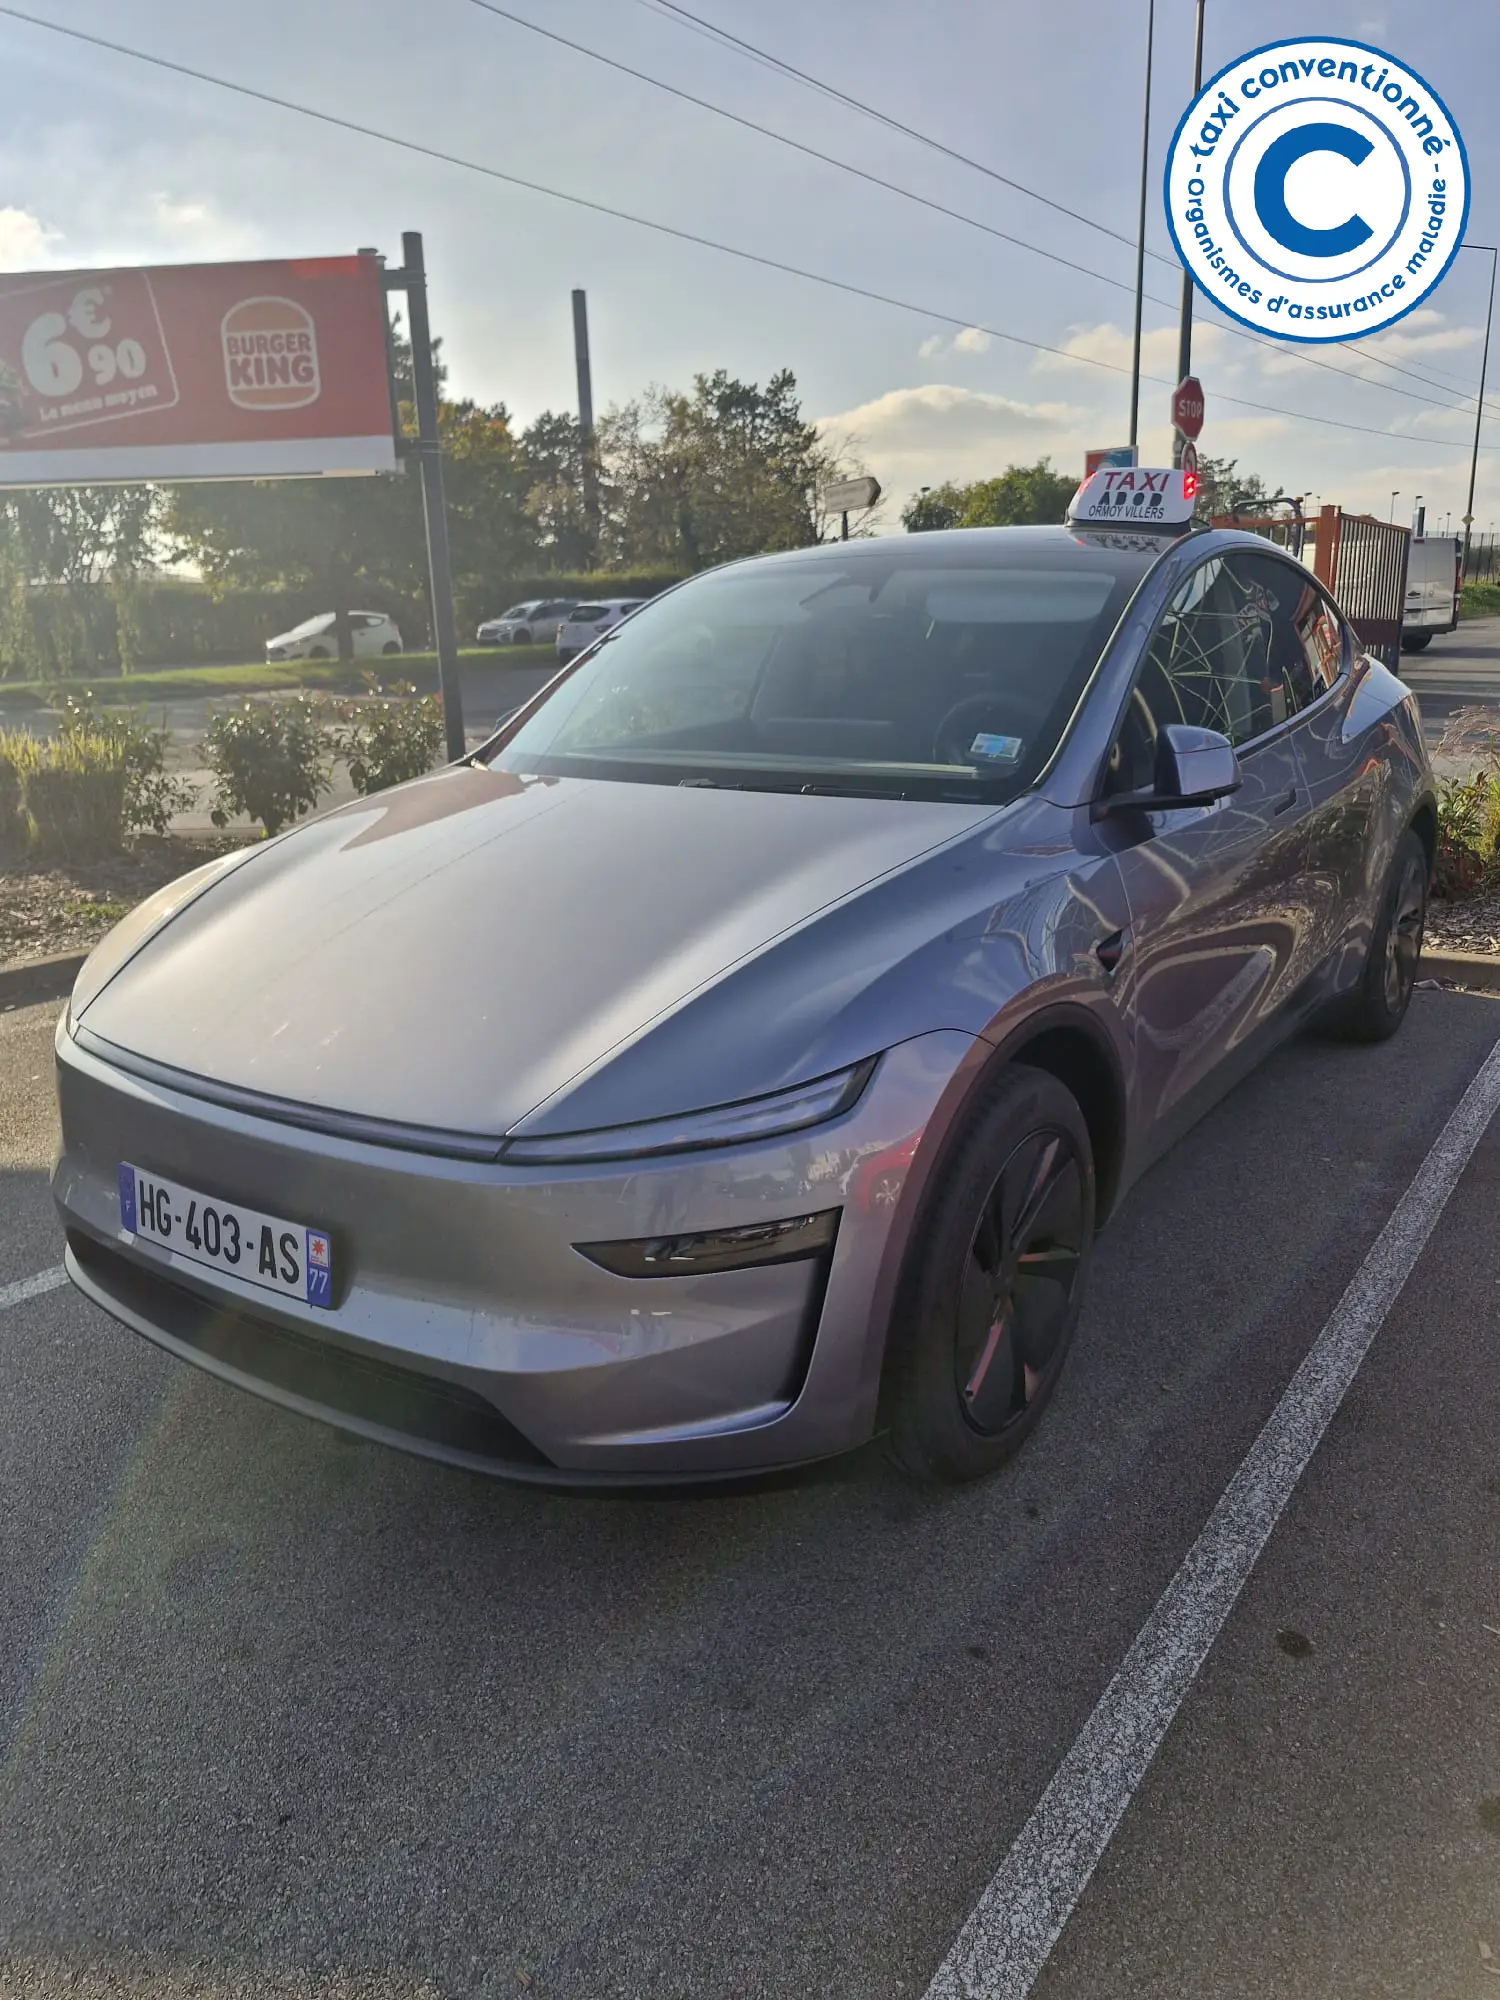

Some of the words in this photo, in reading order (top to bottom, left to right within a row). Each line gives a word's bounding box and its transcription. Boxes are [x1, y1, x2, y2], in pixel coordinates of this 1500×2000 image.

[226, 333, 312, 355] BURGER
[229, 354, 315, 387] KING
[1179, 399, 1202, 418] STOP
[1104, 472, 1170, 492] TAXI
[1088, 505, 1123, 517] ORMOY
[1125, 505, 1165, 519] VILLERS
[139, 1180, 300, 1284] HG-403-AS
[310, 1268, 328, 1294] 77
